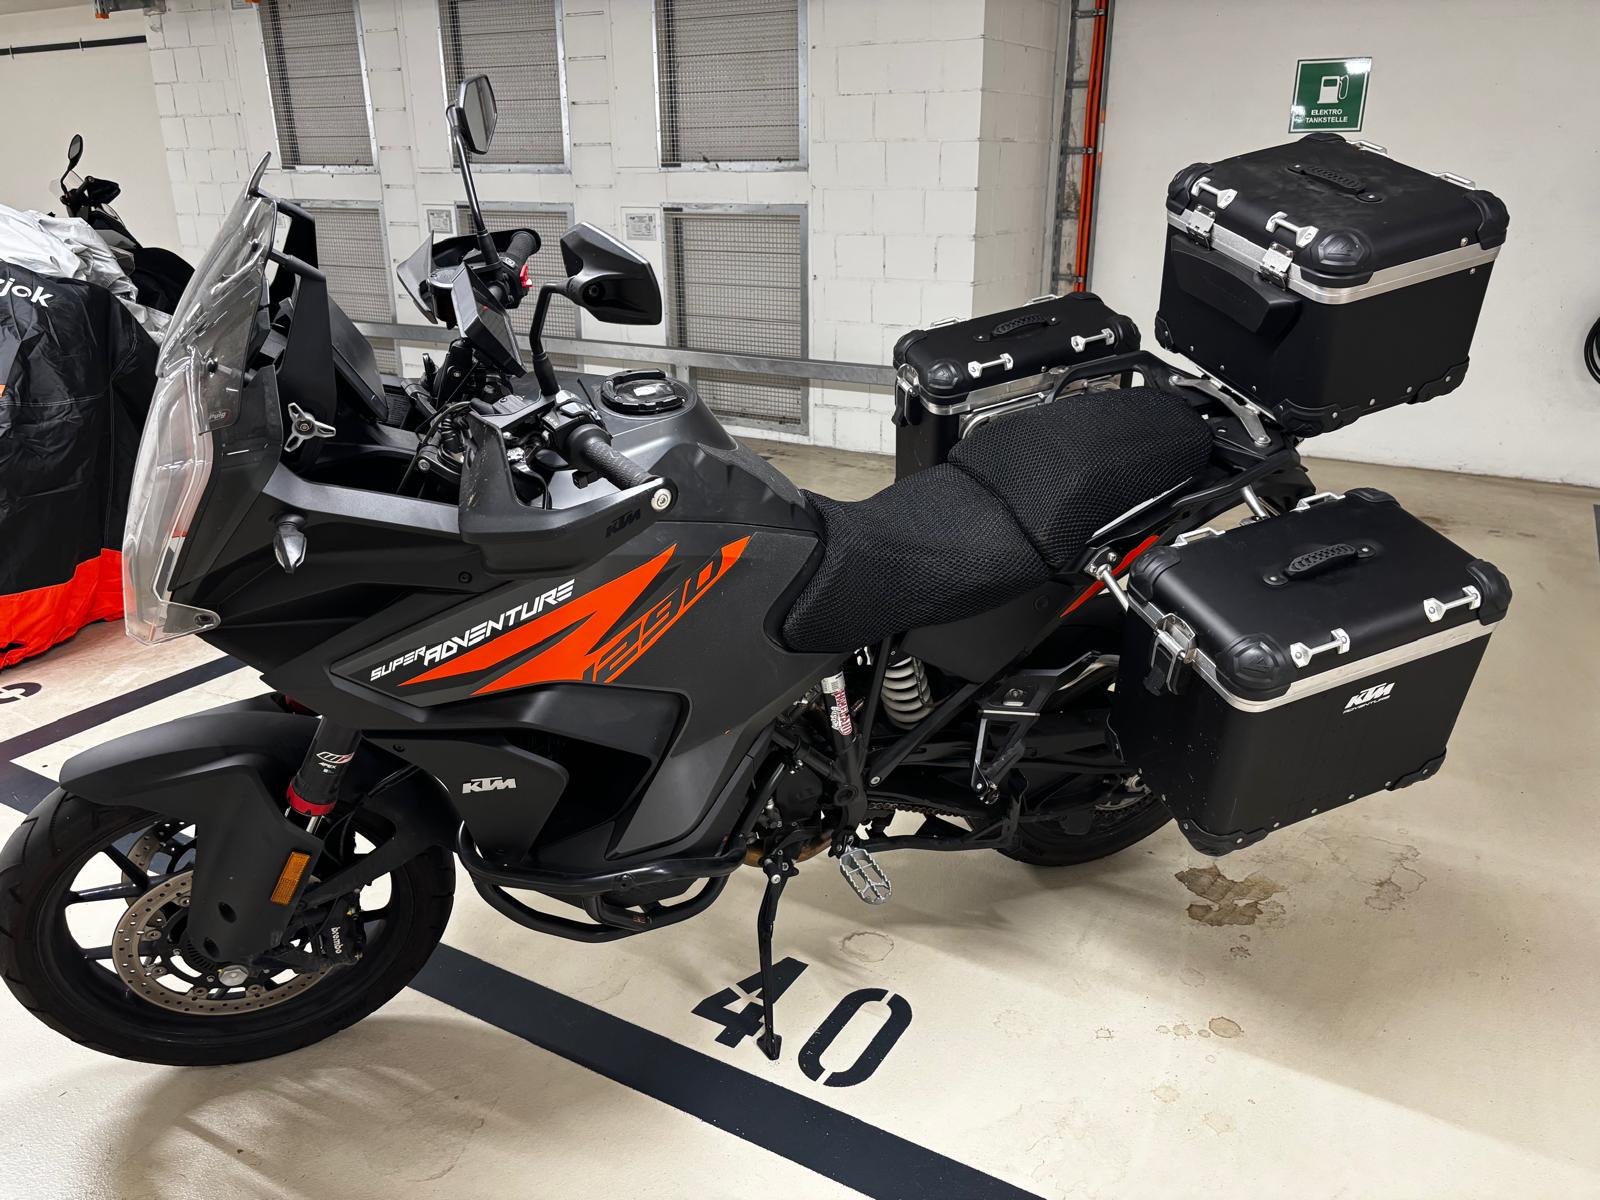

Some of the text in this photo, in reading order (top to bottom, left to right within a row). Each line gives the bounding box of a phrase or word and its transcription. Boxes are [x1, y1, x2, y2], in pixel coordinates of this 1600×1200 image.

[1305, 116, 1349, 124] TANKSTELLE
[370, 578, 575, 681] SUPER ADVENTURE
[1344, 682, 1395, 710] KTM
[462, 776, 517, 794] KTM
[330, 926, 344, 954] brembo
[691, 956, 913, 1087] 40
